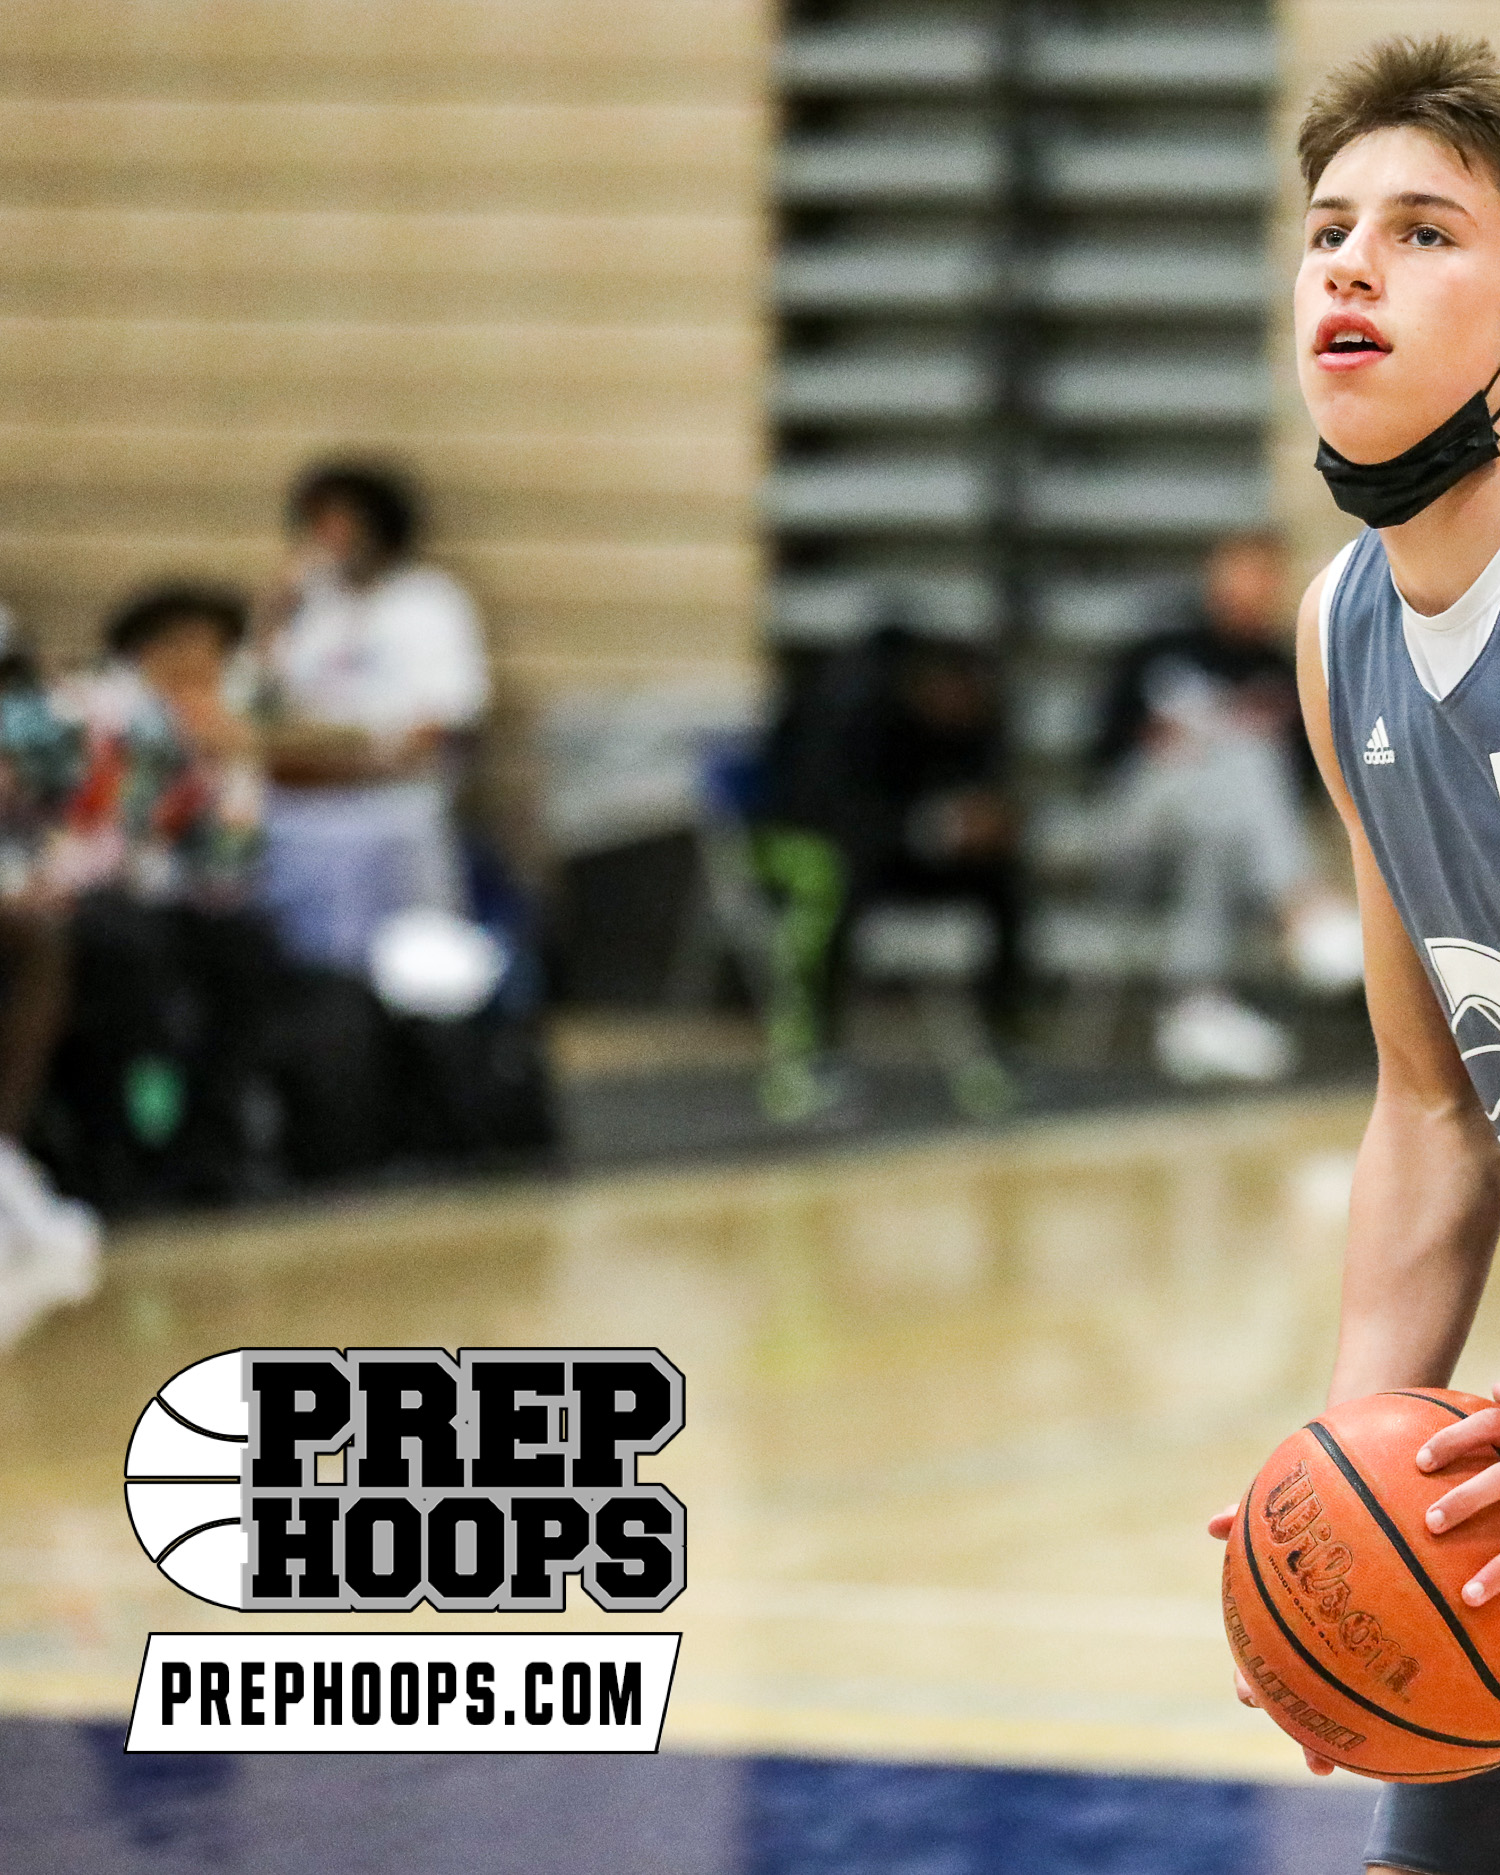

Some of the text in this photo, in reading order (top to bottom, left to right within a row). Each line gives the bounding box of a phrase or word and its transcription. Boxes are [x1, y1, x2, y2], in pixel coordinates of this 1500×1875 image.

[1363, 748, 1395, 766] adidas
[1264, 1459, 1422, 1703] Wilson
[1267, 1555, 1339, 1658] INDOOR GAME BALL
